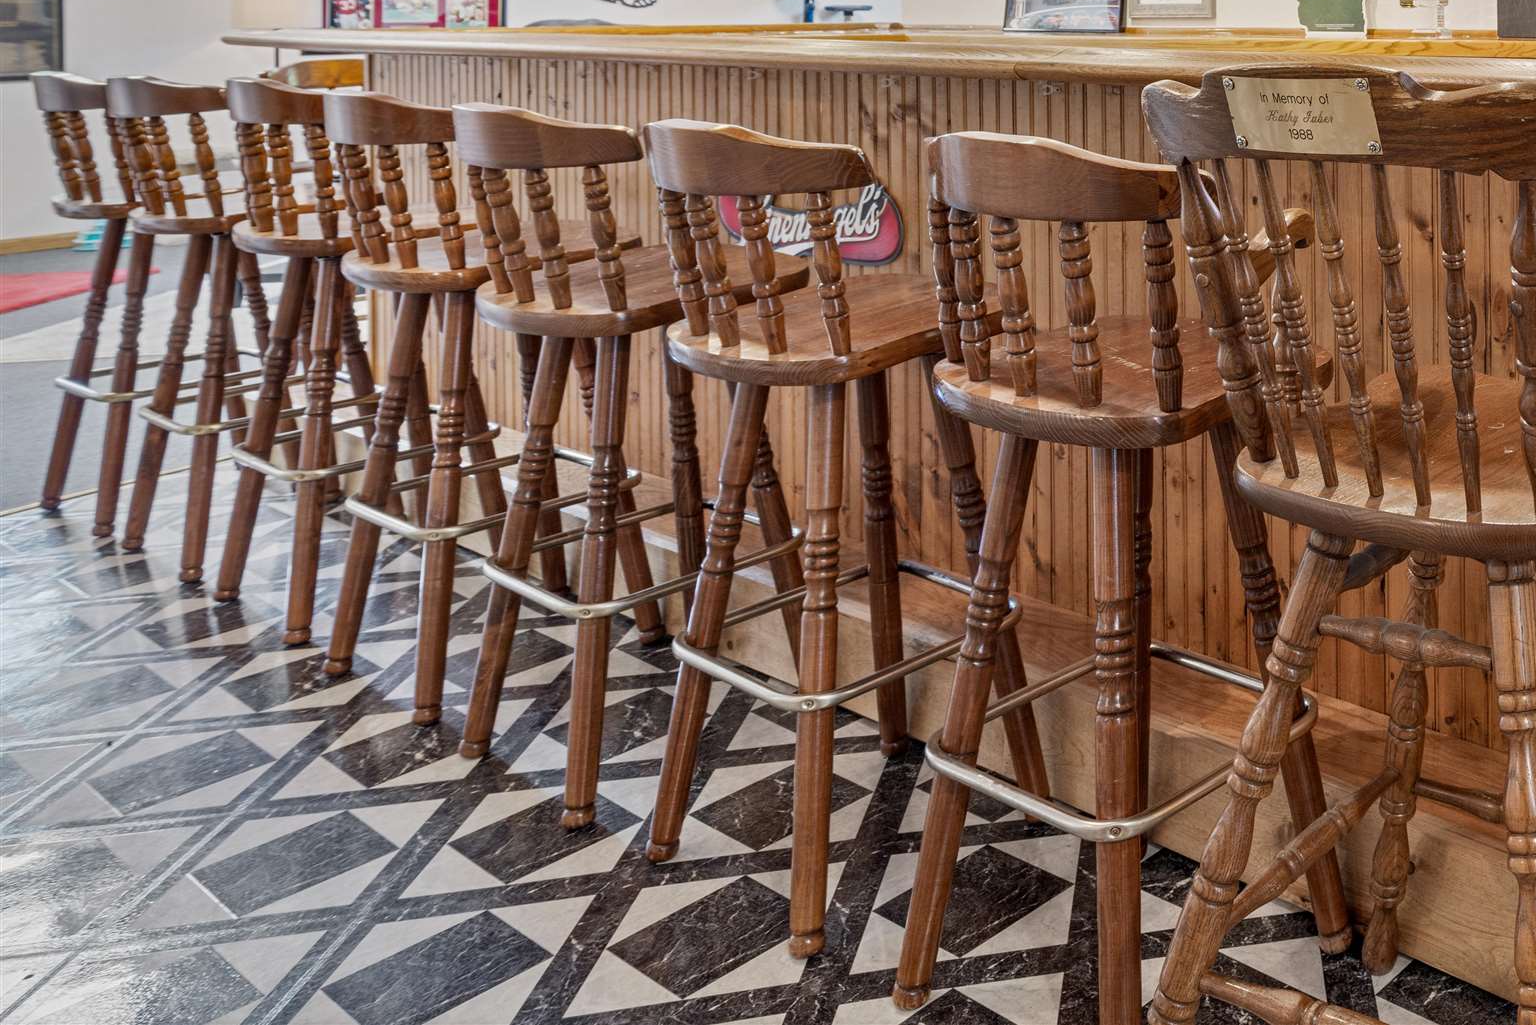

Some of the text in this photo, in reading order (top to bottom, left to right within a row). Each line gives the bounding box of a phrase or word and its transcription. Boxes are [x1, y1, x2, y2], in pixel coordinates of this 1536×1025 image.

[1259, 91, 1329, 107] In Memory of
[1265, 109, 1299, 126] Kathy
[1288, 128, 1315, 141] 1988
